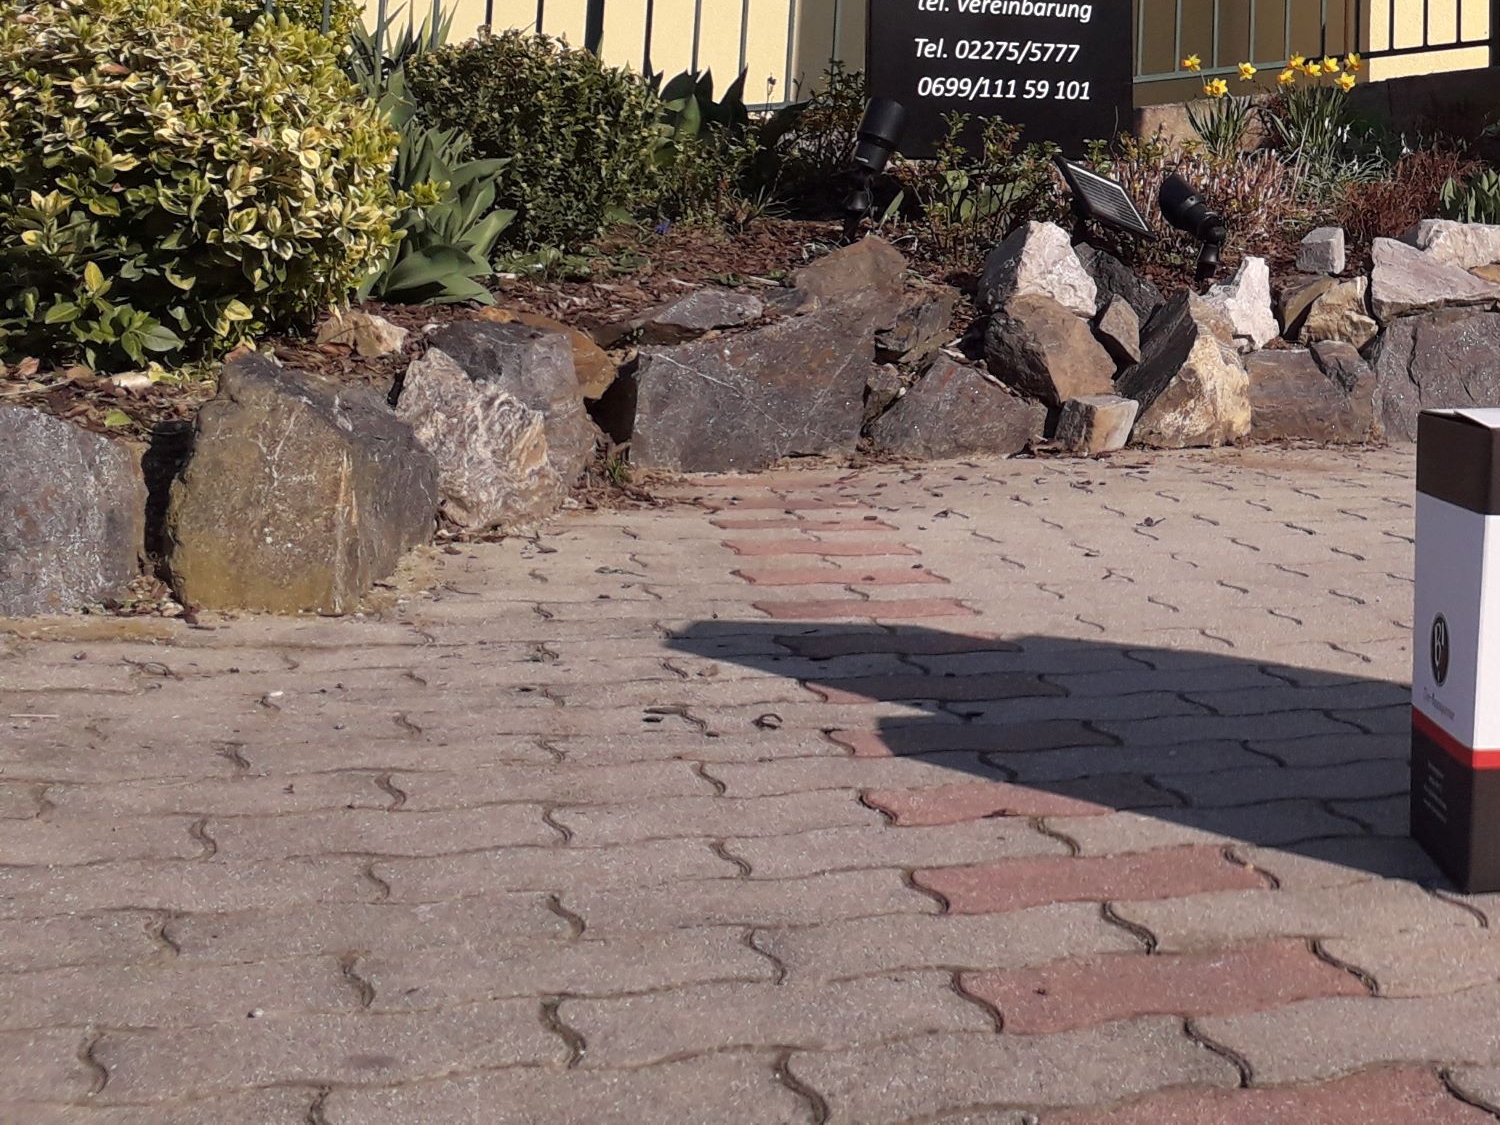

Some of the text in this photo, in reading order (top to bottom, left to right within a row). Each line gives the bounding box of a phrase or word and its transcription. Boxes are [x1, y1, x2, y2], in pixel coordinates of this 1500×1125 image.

[913, 38, 1080, 65] Tel. 02275/5777
[917, 77, 1091, 102] 0699/111 59 101
